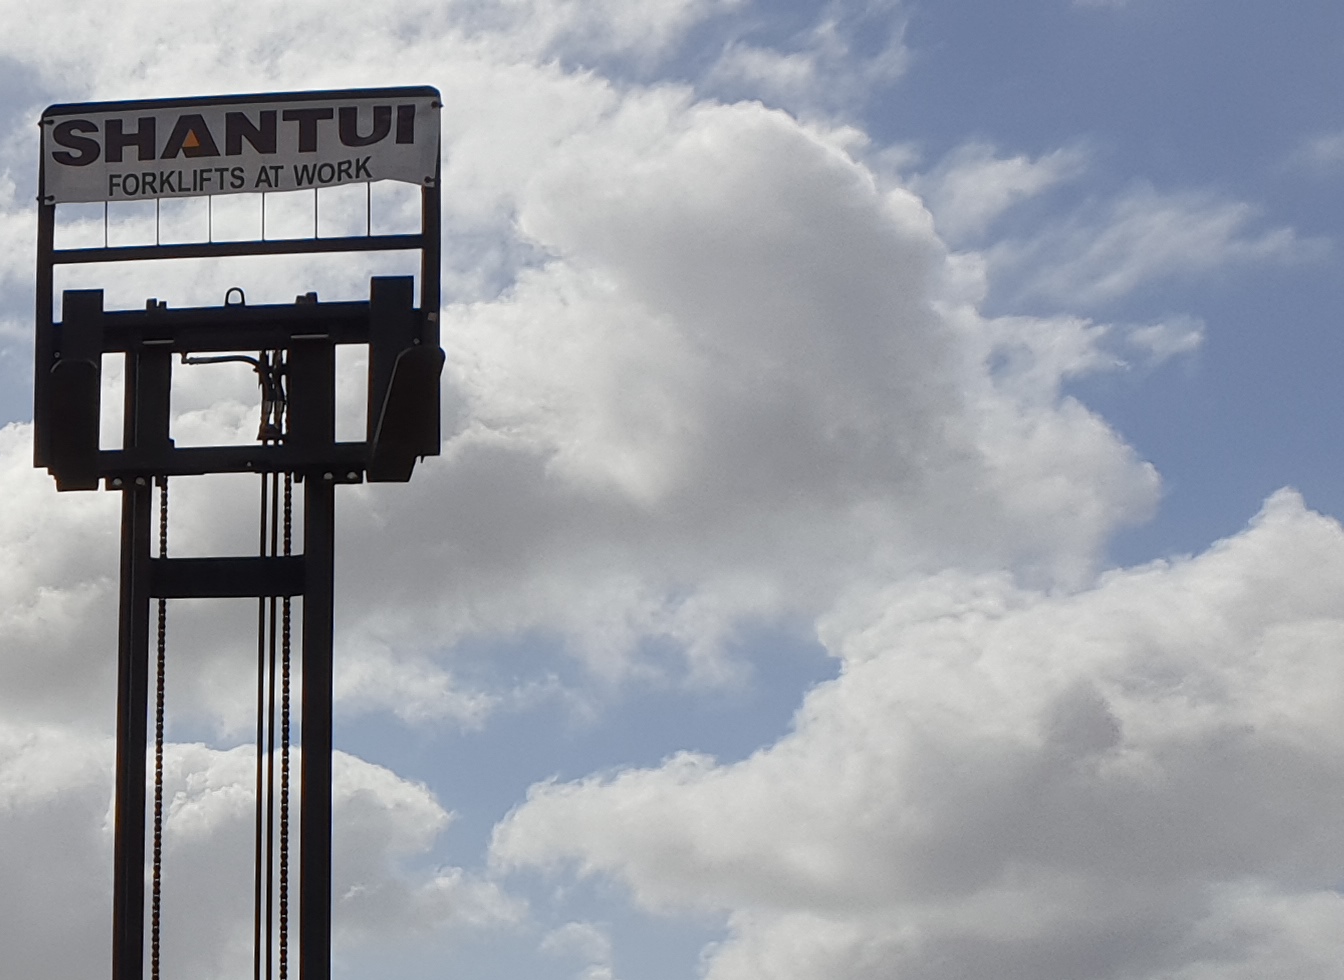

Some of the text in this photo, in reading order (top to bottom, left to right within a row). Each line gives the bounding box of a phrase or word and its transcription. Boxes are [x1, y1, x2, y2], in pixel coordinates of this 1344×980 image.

[52, 104, 416, 167] SHANTUI
[108, 156, 373, 197] FORKLIFTS AT WORK
